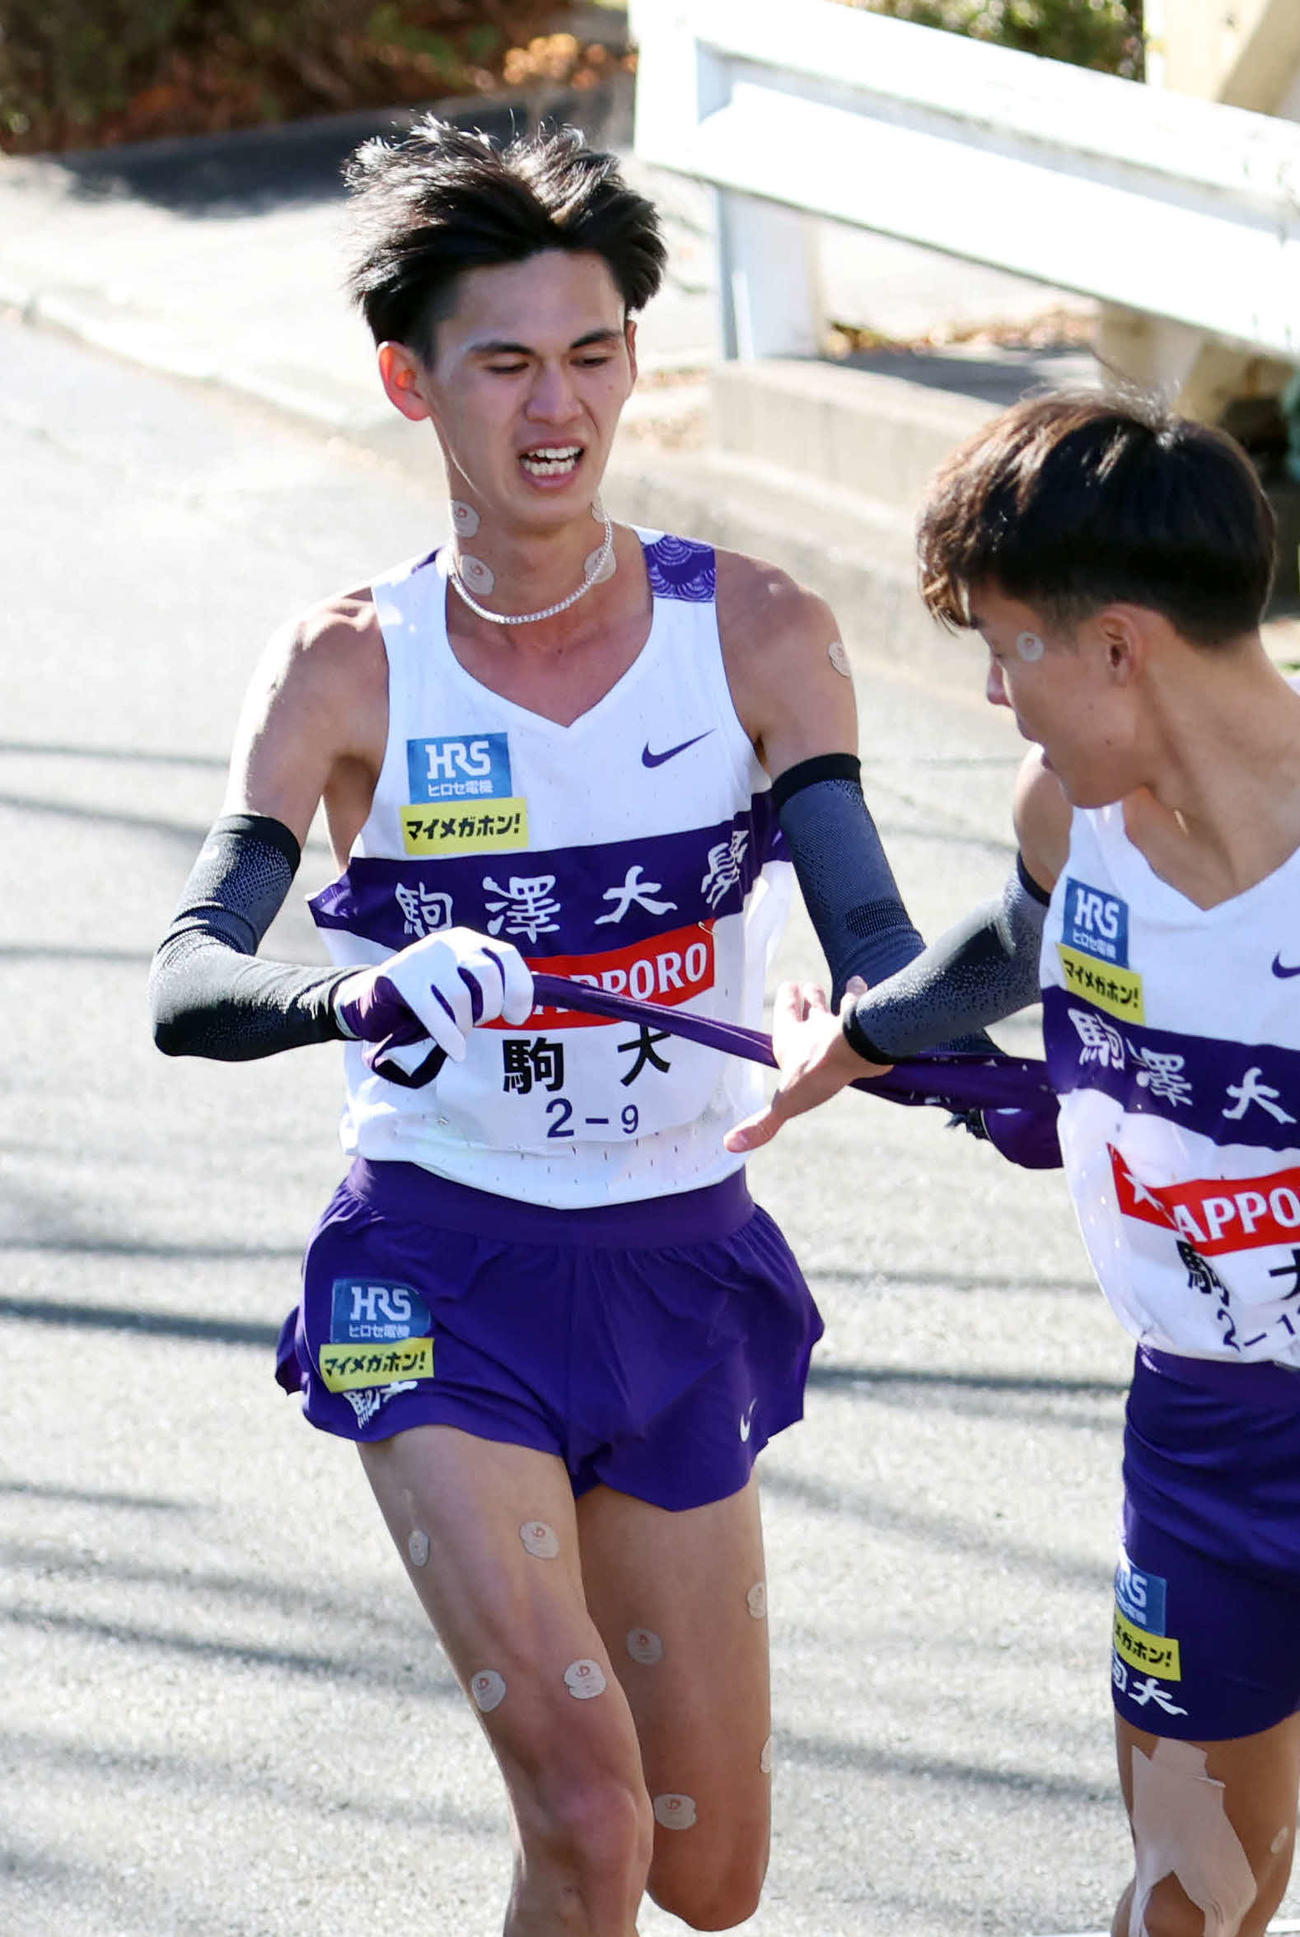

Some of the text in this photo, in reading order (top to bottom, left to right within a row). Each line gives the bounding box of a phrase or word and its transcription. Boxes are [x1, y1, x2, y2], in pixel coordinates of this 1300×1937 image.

[425, 740, 491, 779] HRS
[406, 813, 521, 840] マイメガホン!
[1073, 887, 1120, 940] HRS
[1063, 958, 1139, 1008] マイメガホン!
[1172, 1187, 1300, 1244] APPO
[350, 1286, 412, 1322] HRS
[1216, 1305, 1300, 1352] 2-1
[324, 1350, 426, 1377] マイメガホン!
